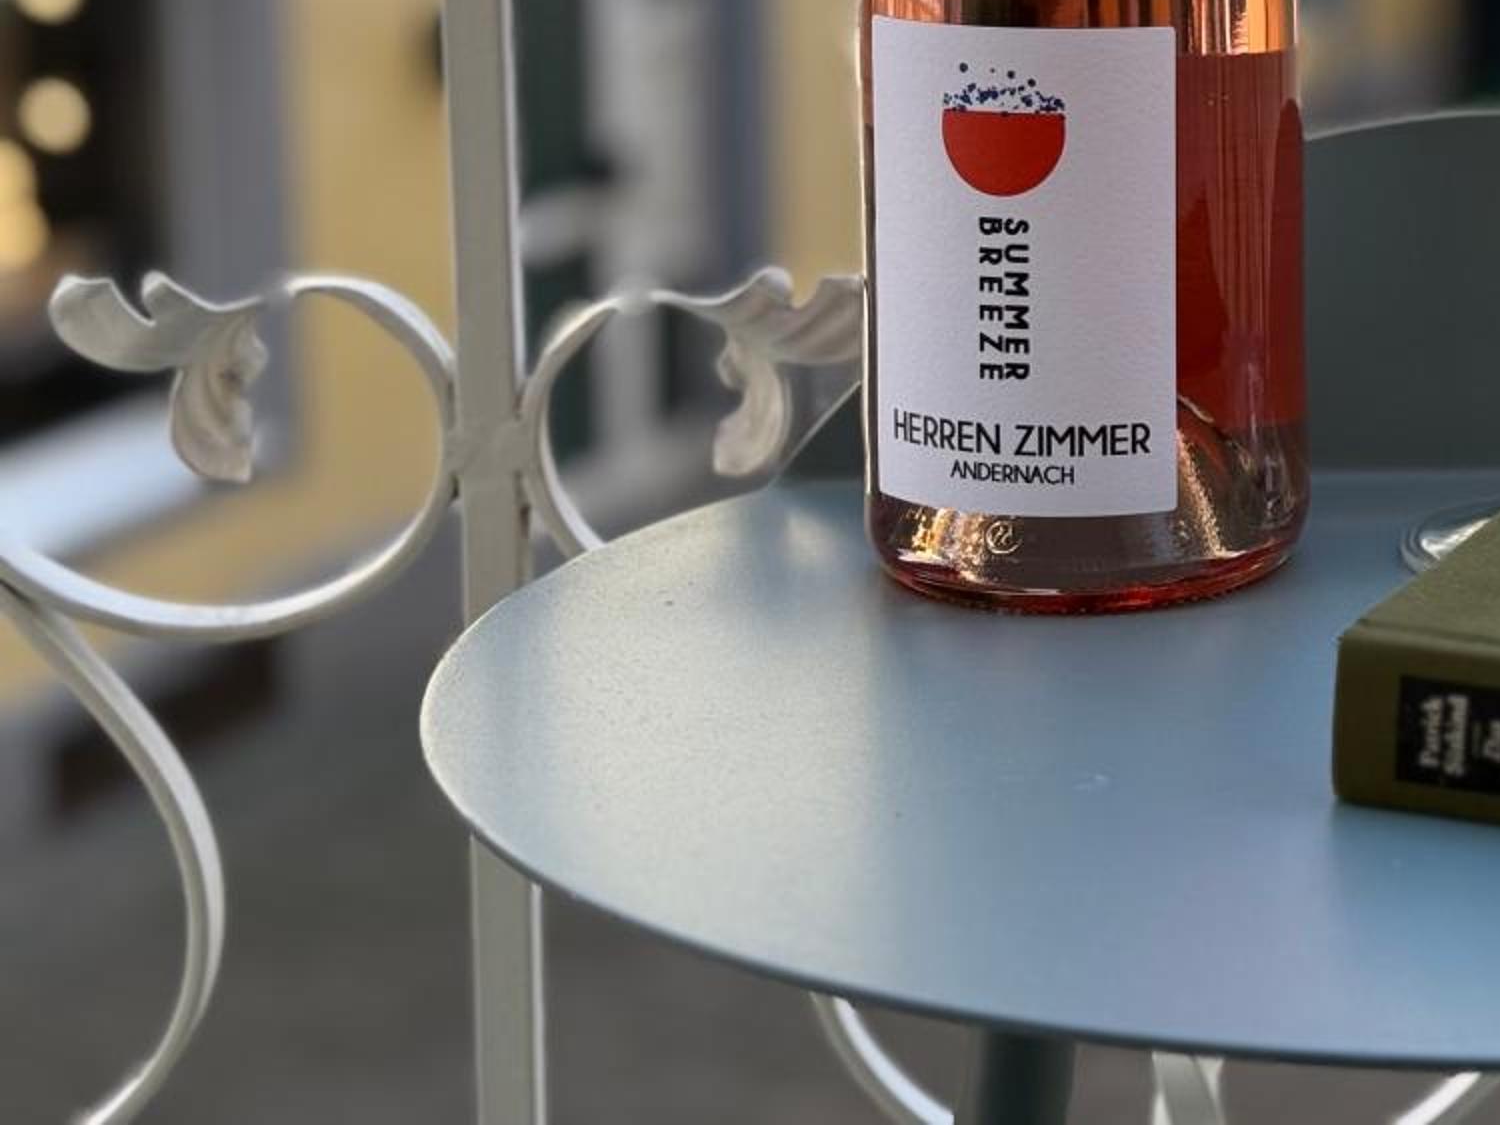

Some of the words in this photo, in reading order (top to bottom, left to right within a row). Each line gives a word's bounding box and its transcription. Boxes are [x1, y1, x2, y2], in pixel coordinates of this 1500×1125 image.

[978, 216, 1003, 380] BREEZE
[1003, 217, 1029, 380] SUMMER
[893, 408, 1001, 455] HERREN
[1013, 422, 1151, 458] ZIMMER
[950, 459, 1075, 486] ANDERNACH
